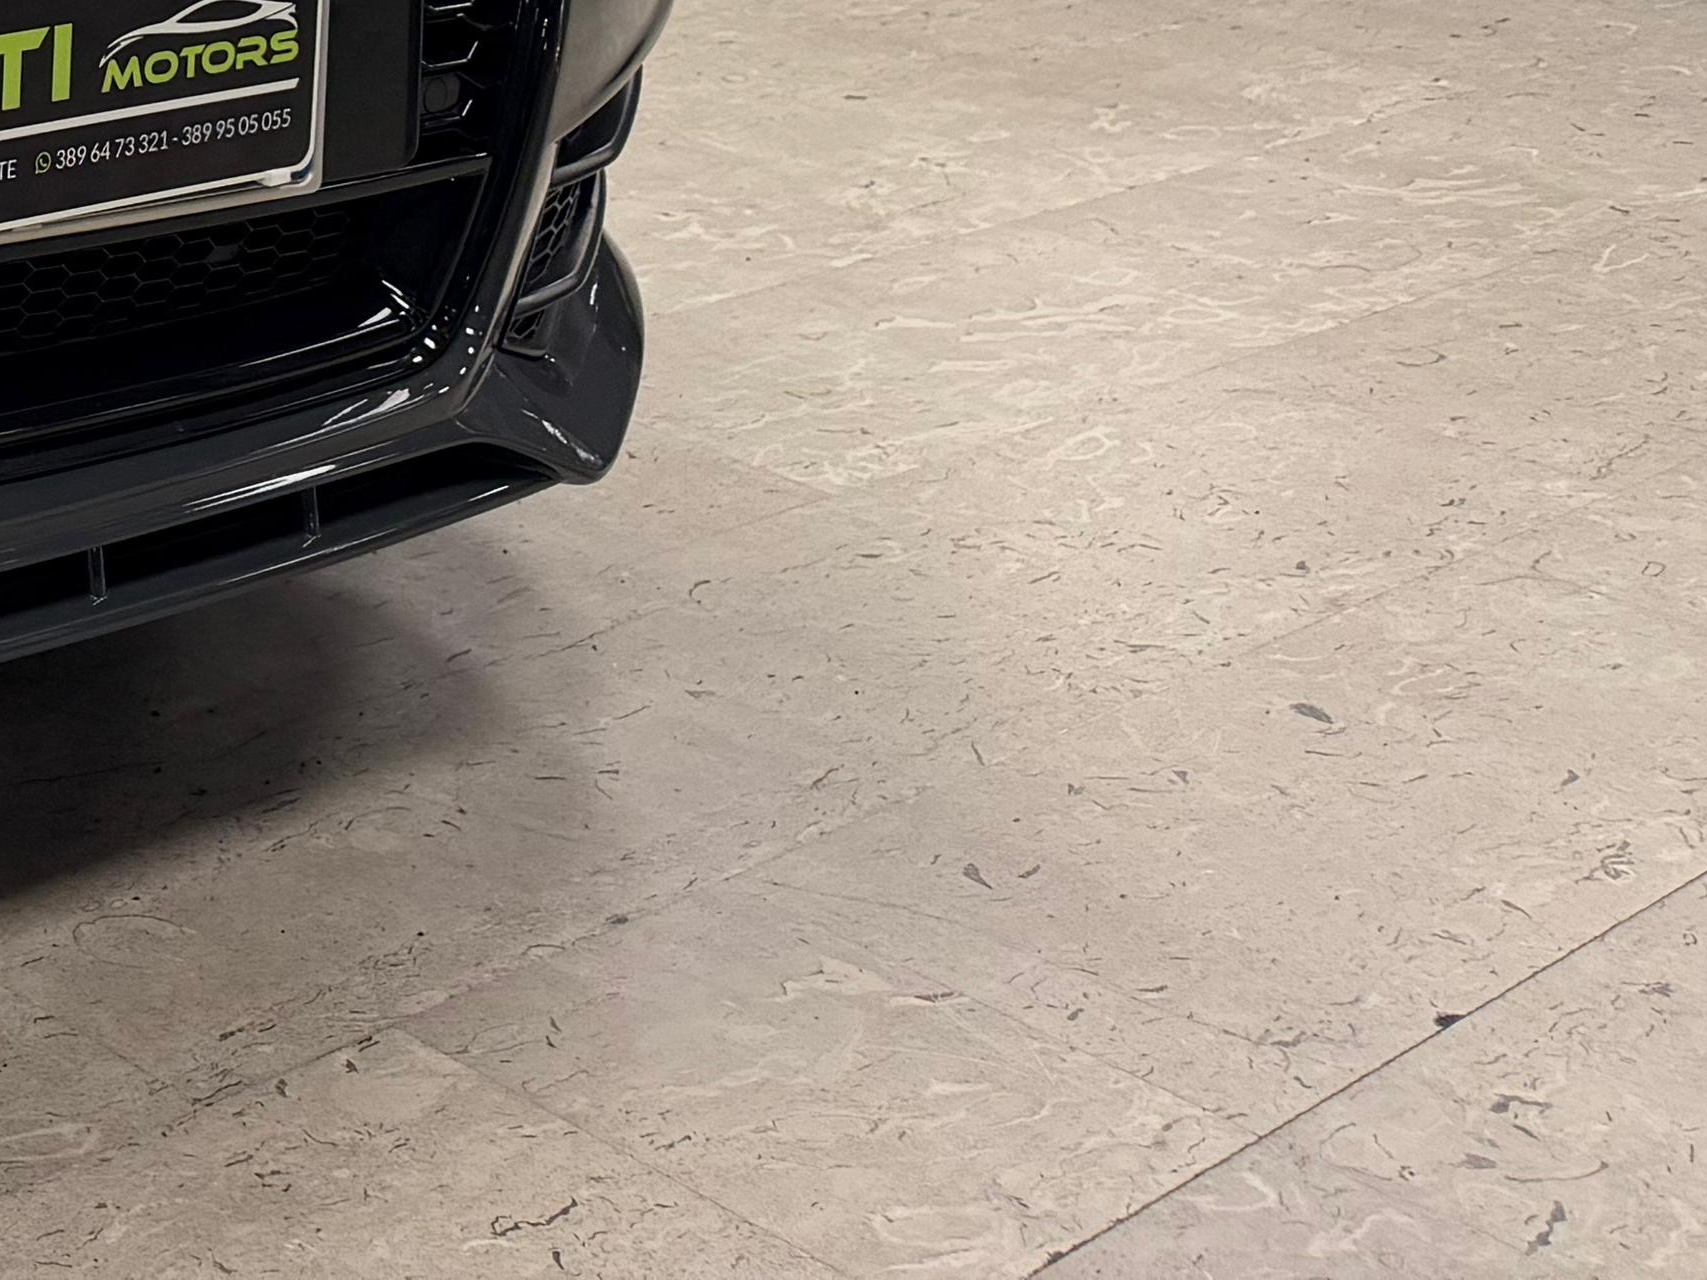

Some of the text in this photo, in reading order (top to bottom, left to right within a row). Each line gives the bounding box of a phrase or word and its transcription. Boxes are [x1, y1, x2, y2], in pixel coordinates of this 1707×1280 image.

[101, 29, 300, 93] MOTORS
[55, 145, 87, 170] 389
[90, 140, 110, 162] 64
[115, 137, 135, 158] 73
[138, 130, 168, 155] 321
[182, 122, 211, 147] 389
[216, 117, 236, 140] 95
[238, 113, 259, 135] 05
[261, 107, 292, 132] 055
